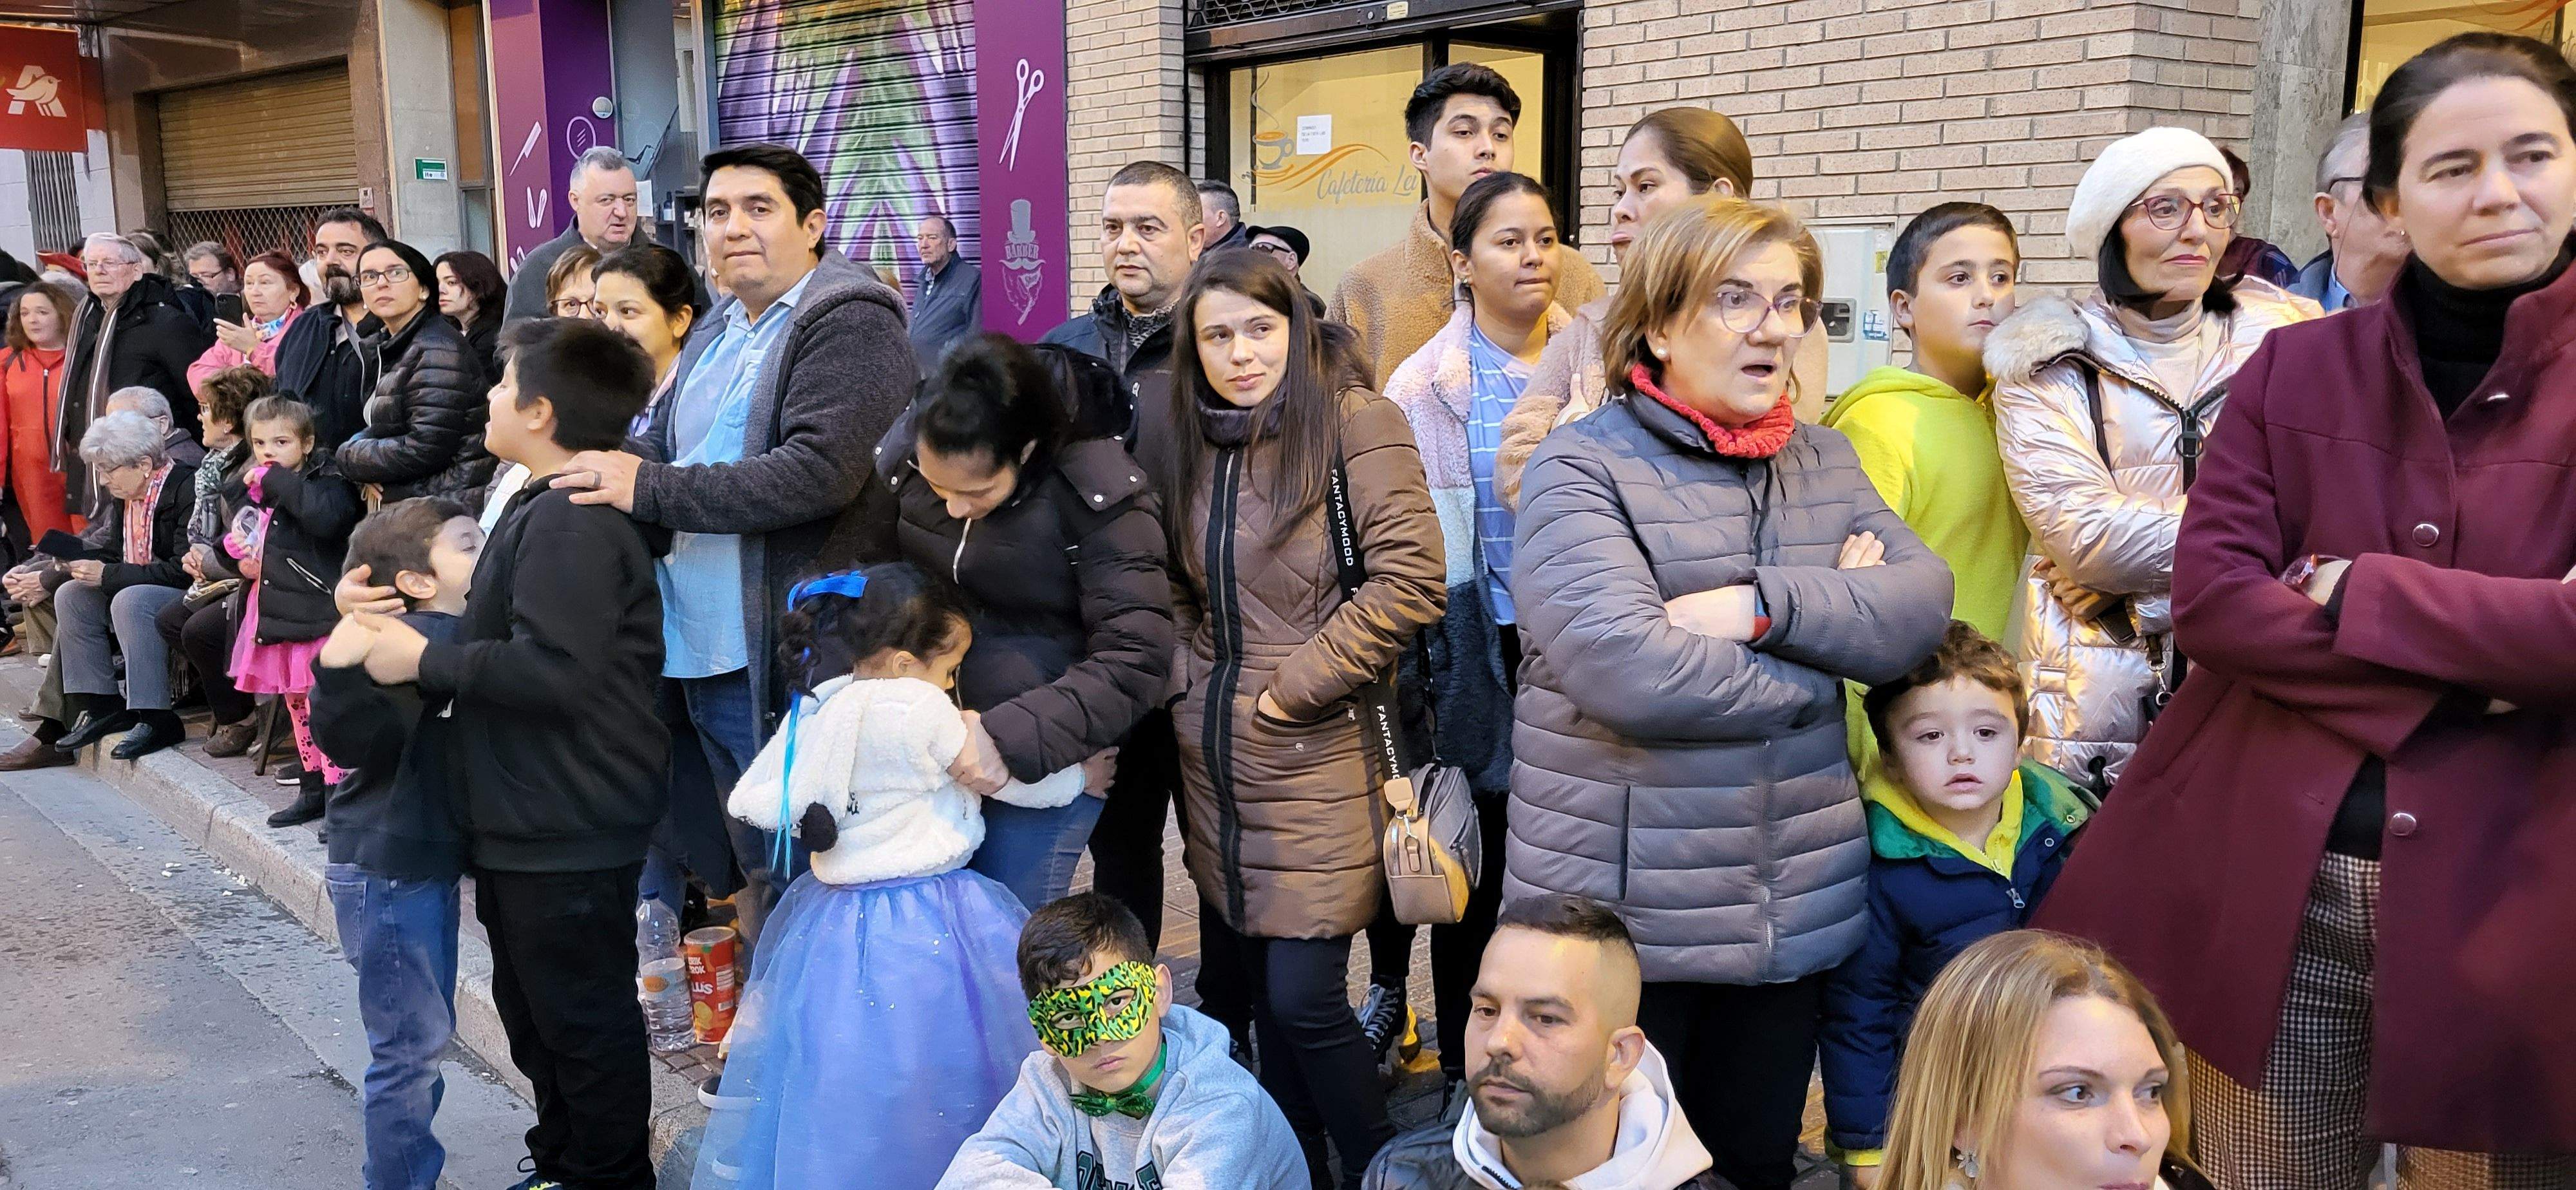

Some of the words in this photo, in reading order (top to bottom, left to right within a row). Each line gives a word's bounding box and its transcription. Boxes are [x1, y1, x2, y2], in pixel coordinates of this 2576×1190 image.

[1317, 169, 1388, 204] Cafetería
[1005, 244, 1039, 260] BARBER
[1331, 469, 1354, 566] FANTACYMOOD
[1376, 705, 1400, 780] FANTACYMO
